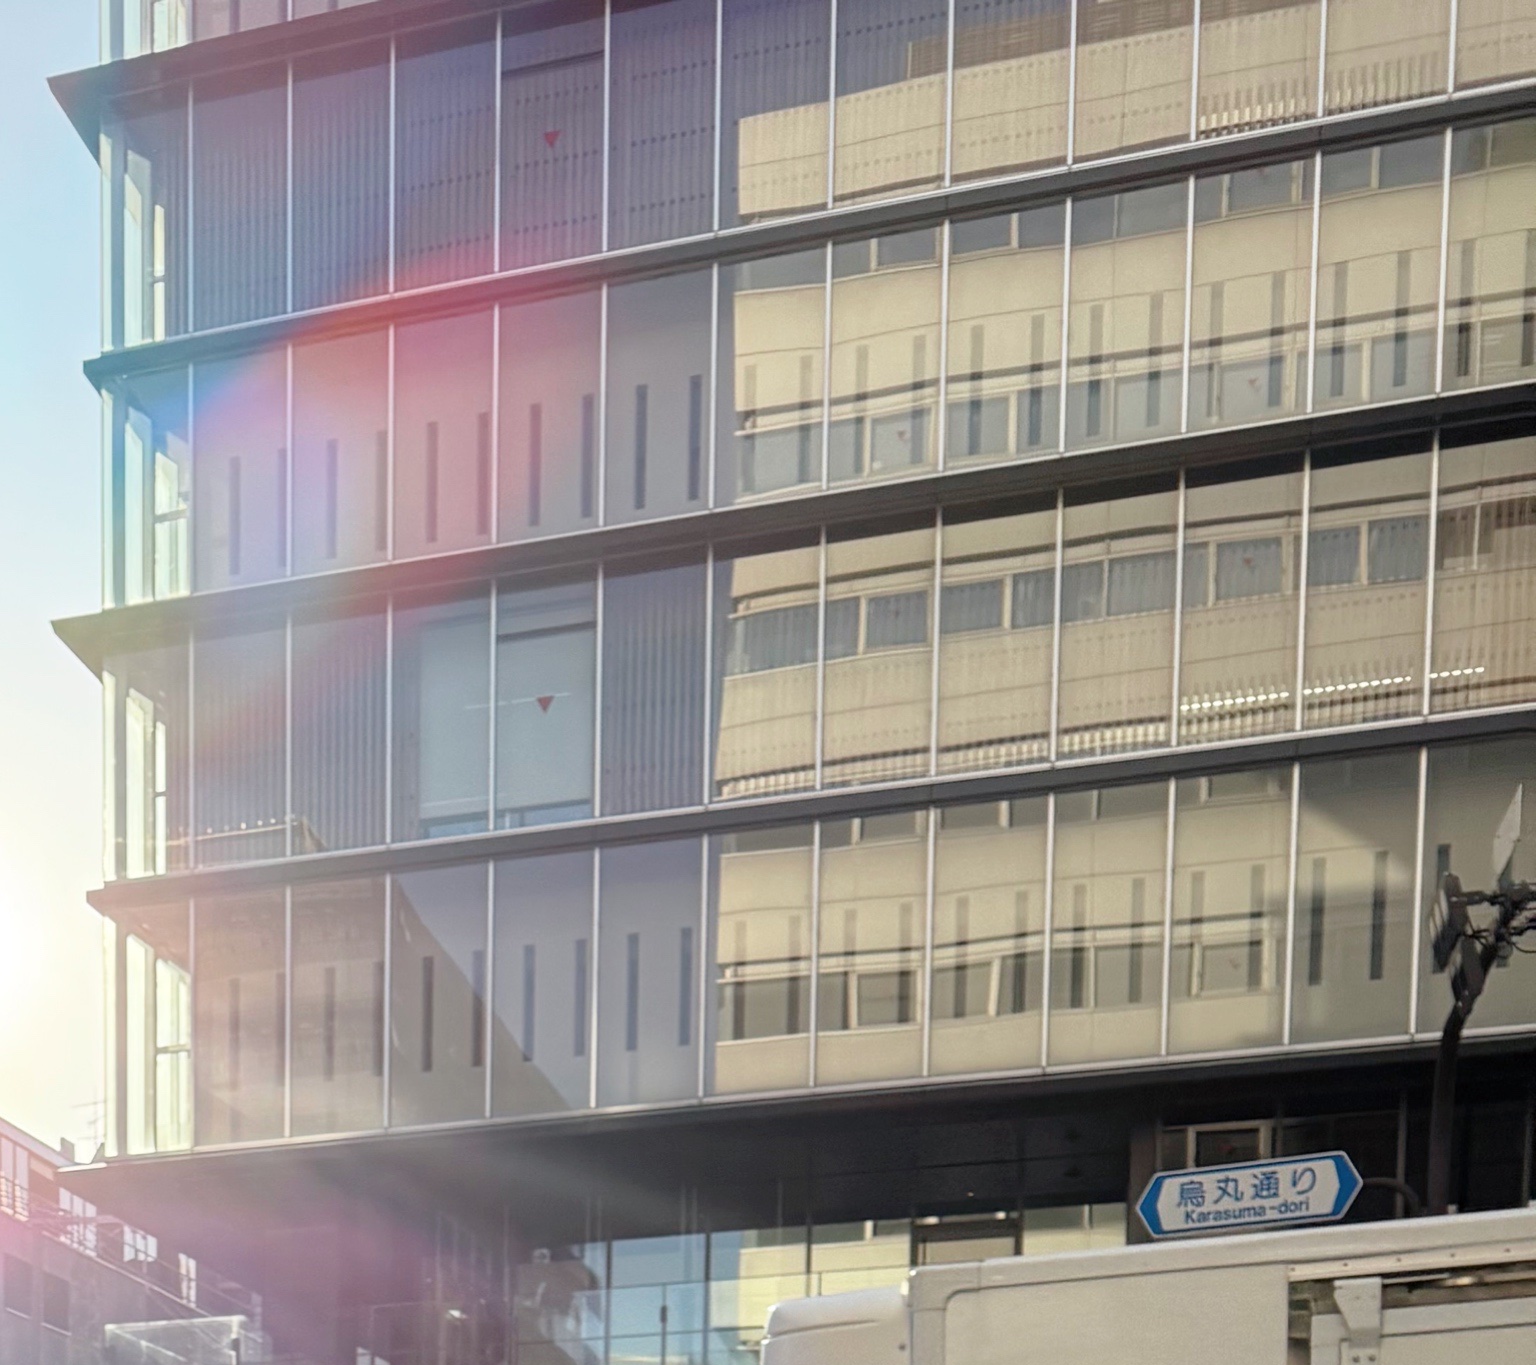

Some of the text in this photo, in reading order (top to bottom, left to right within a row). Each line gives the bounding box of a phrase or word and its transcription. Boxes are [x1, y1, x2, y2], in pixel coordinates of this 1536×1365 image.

[1176, 1166, 1317, 1209] 烏丸通り
[1183, 1195, 1311, 1225] Karasuma-dori
